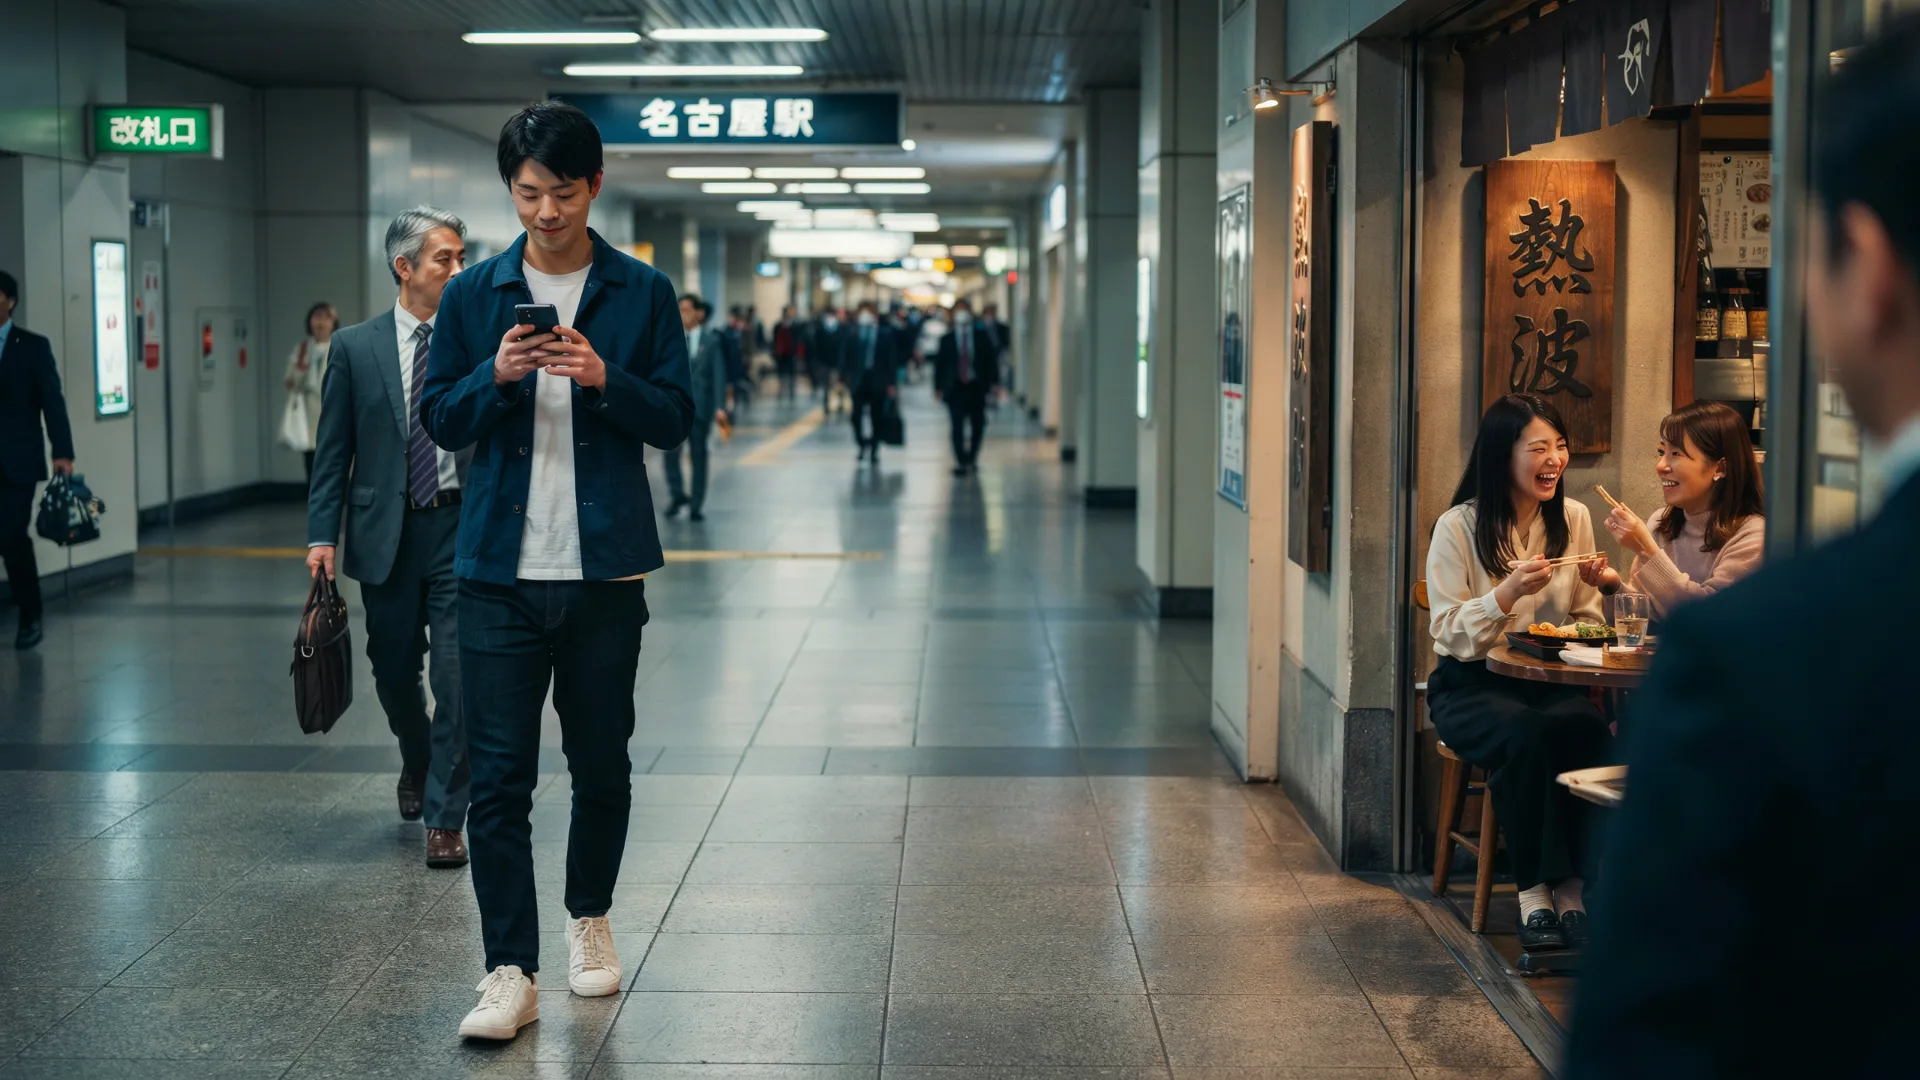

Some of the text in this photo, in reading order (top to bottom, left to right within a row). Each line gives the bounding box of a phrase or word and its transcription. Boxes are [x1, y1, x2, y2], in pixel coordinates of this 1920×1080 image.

[109, 115, 196, 146] 改札口
[638, 97, 815, 138] 名古屋駅
[1508, 197, 1595, 399] 熱波
